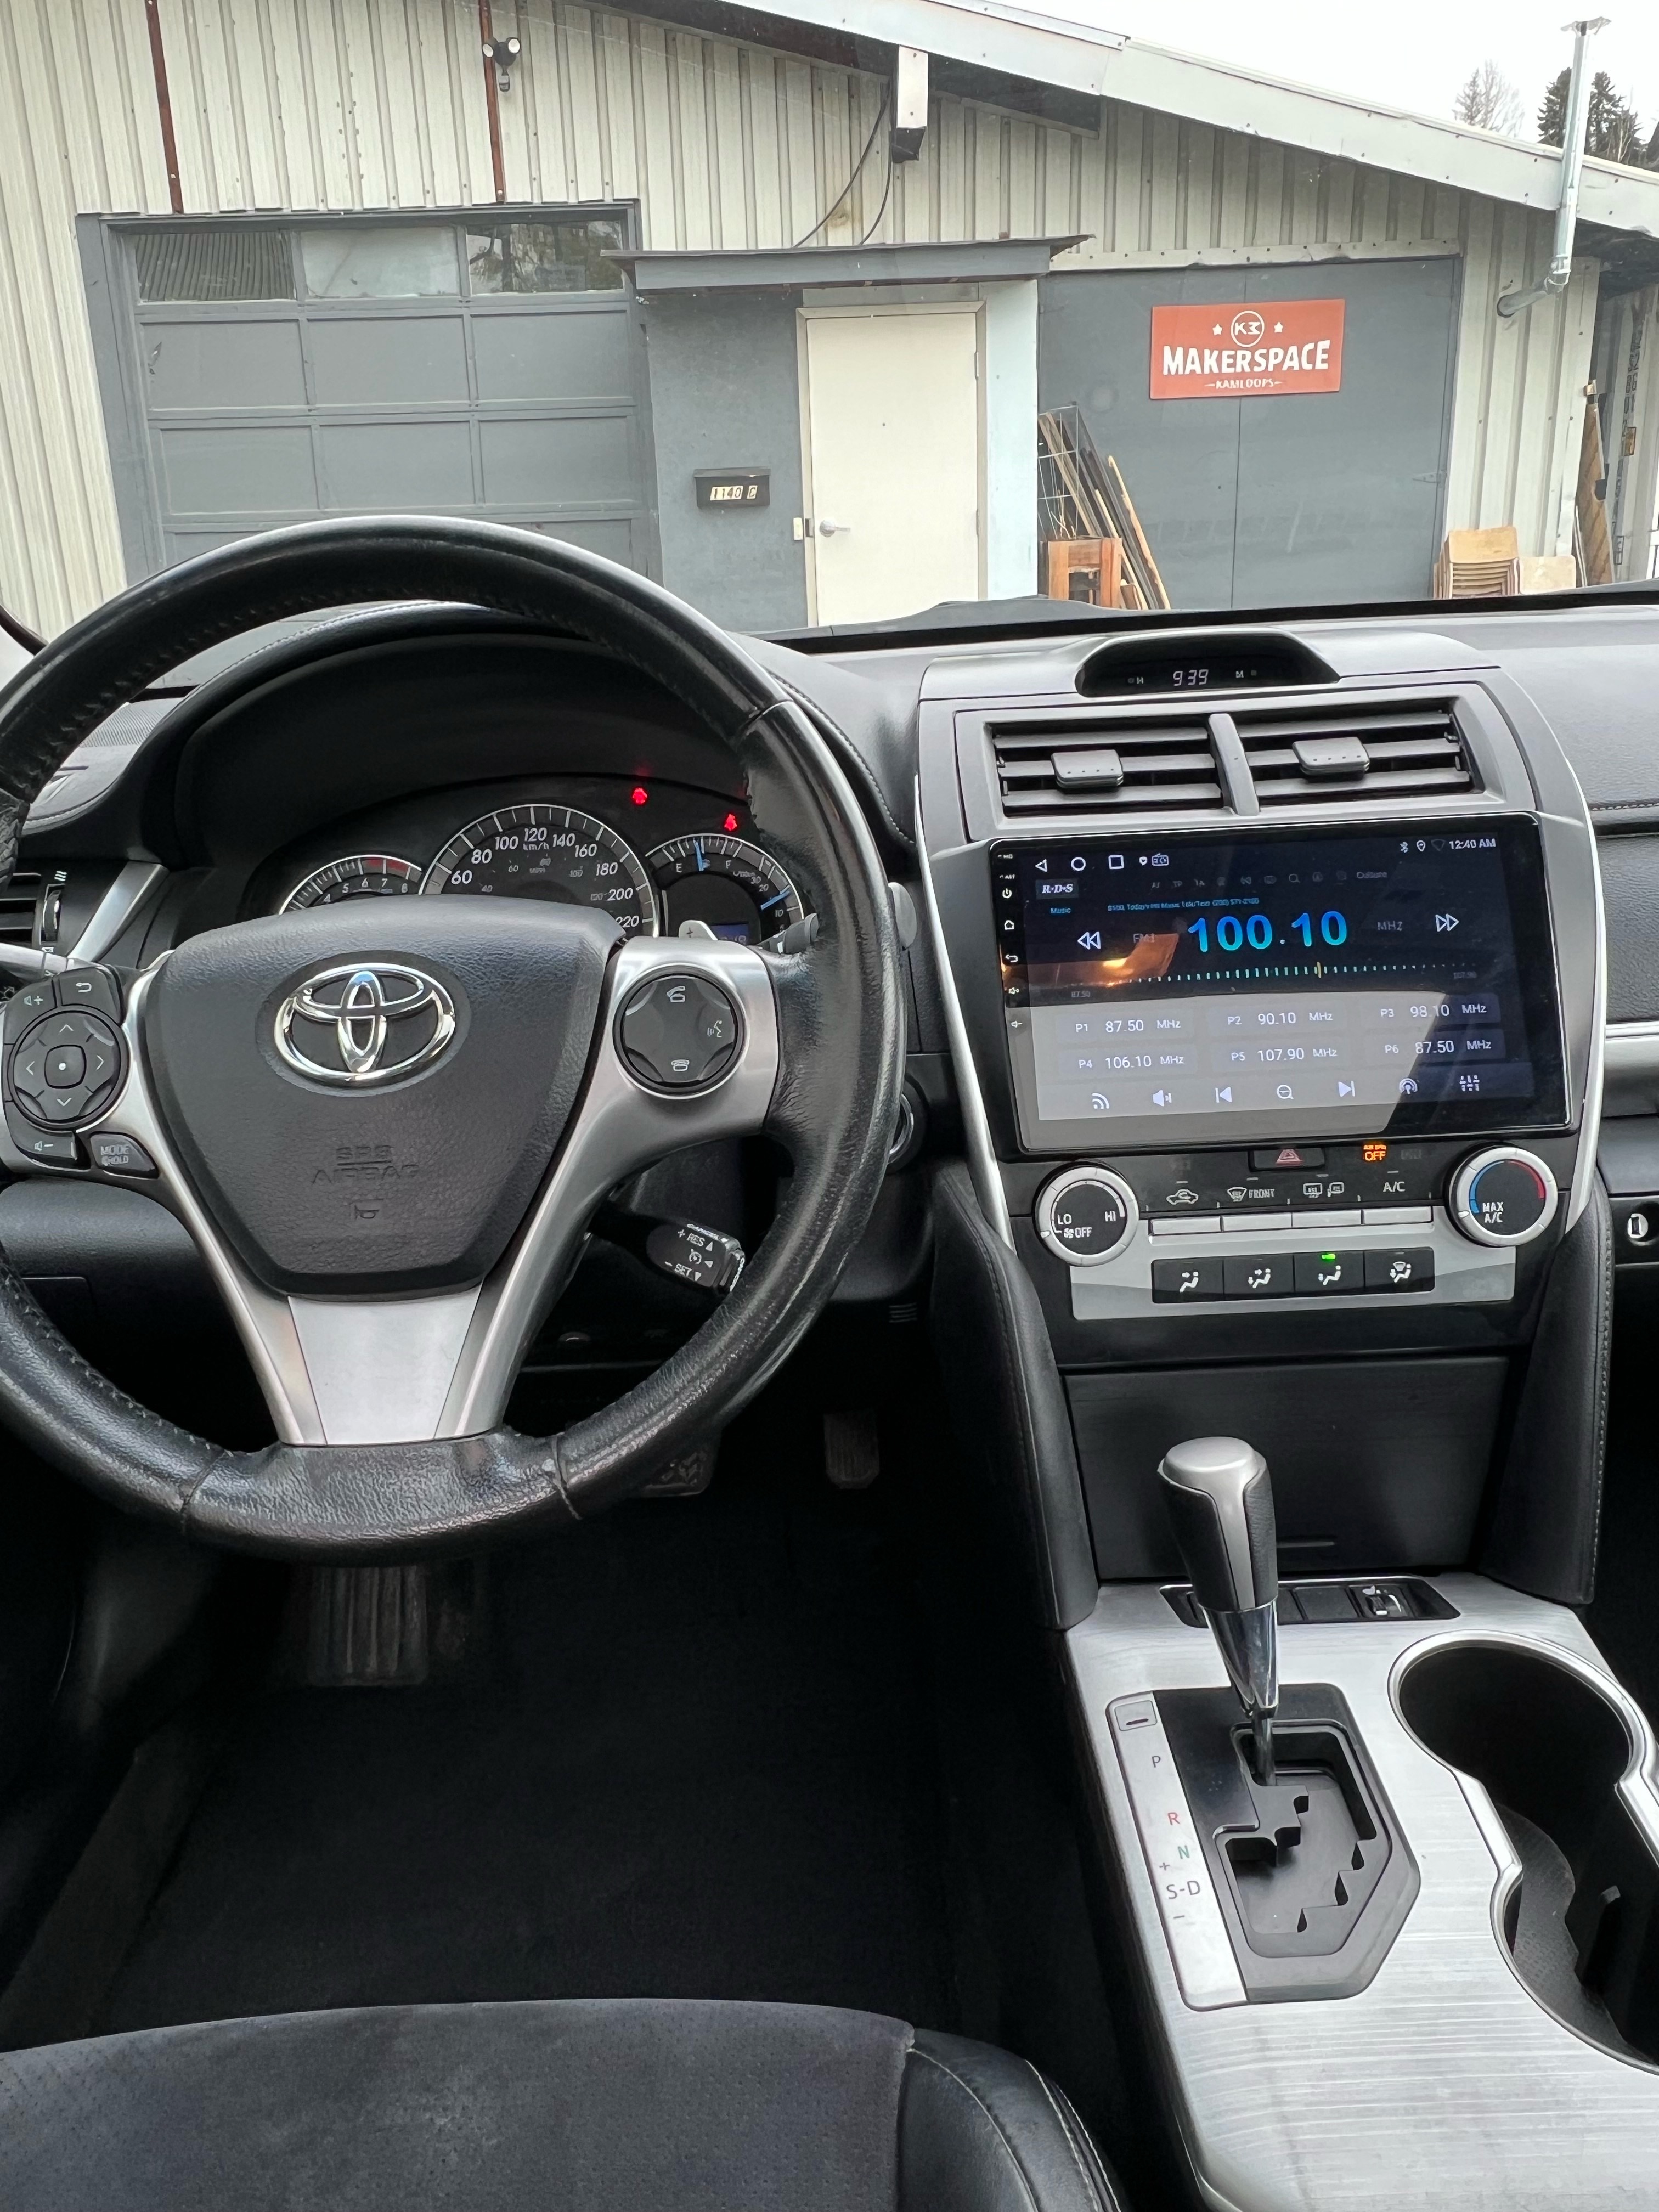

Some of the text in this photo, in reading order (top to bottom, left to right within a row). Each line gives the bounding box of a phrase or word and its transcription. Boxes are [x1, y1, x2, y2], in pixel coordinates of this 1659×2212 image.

[1163, 340, 1331, 375] MAKERSPACE
[1216, 378, 1274, 389] KAMLOOPS
[714, 487, 742, 499] 1140
[524, 827, 547, 842] 120
[552, 833, 575, 848] 140
[495, 836, 518, 850] 100
[523, 841, 549, 851] km/h
[1479, 838, 1496, 848] AM
[471, 848, 492, 865] 80
[574, 843, 597, 858] 160
[596, 862, 618, 876] 180
[676, 863, 682, 873] E
[725, 860, 732, 869] F
[362, 877, 369, 888] 6
[381, 878, 388, 888] 7
[450, 869, 473, 885] 60
[342, 883, 349, 894] 5
[401, 883, 408, 893] 8
[607, 887, 633, 901] 200
[759, 884, 769, 893] 20
[323, 894, 331, 902] 4
[775, 909, 783, 917] 10
[1188, 911, 1347, 953] 100.10
[1380, 1003, 1487, 1018] P3 98.10 MHz
[1076, 1019, 1181, 1032] P1 87.50 MHz
[1227, 1012, 1333, 1026] P2 90.10 MHz
[1385, 1039, 1492, 1054] P6 87.50 MHz
[1079, 1054, 1185, 1069] P4 106.10 MHz
[1231, 1048, 1338, 1062] P5 107.90 MHz
[1364, 1150, 1386, 1161] OFF
[1383, 1181, 1406, 1192] A/C
[1248, 1188, 1276, 1200] FRONT
[1482, 1201, 1504, 1213] MAX
[1057, 1213, 1072, 1226] LO
[1104, 1211, 1117, 1222] HI
[1484, 1212, 1503, 1224] A/C
[1075, 1227, 1092, 1238] OFF
[1152, 1755, 1162, 1768] P
[1167, 1812, 1181, 1826] R
[1177, 1845, 1190, 1860] N
[1166, 1880, 1201, 1900] S-D
